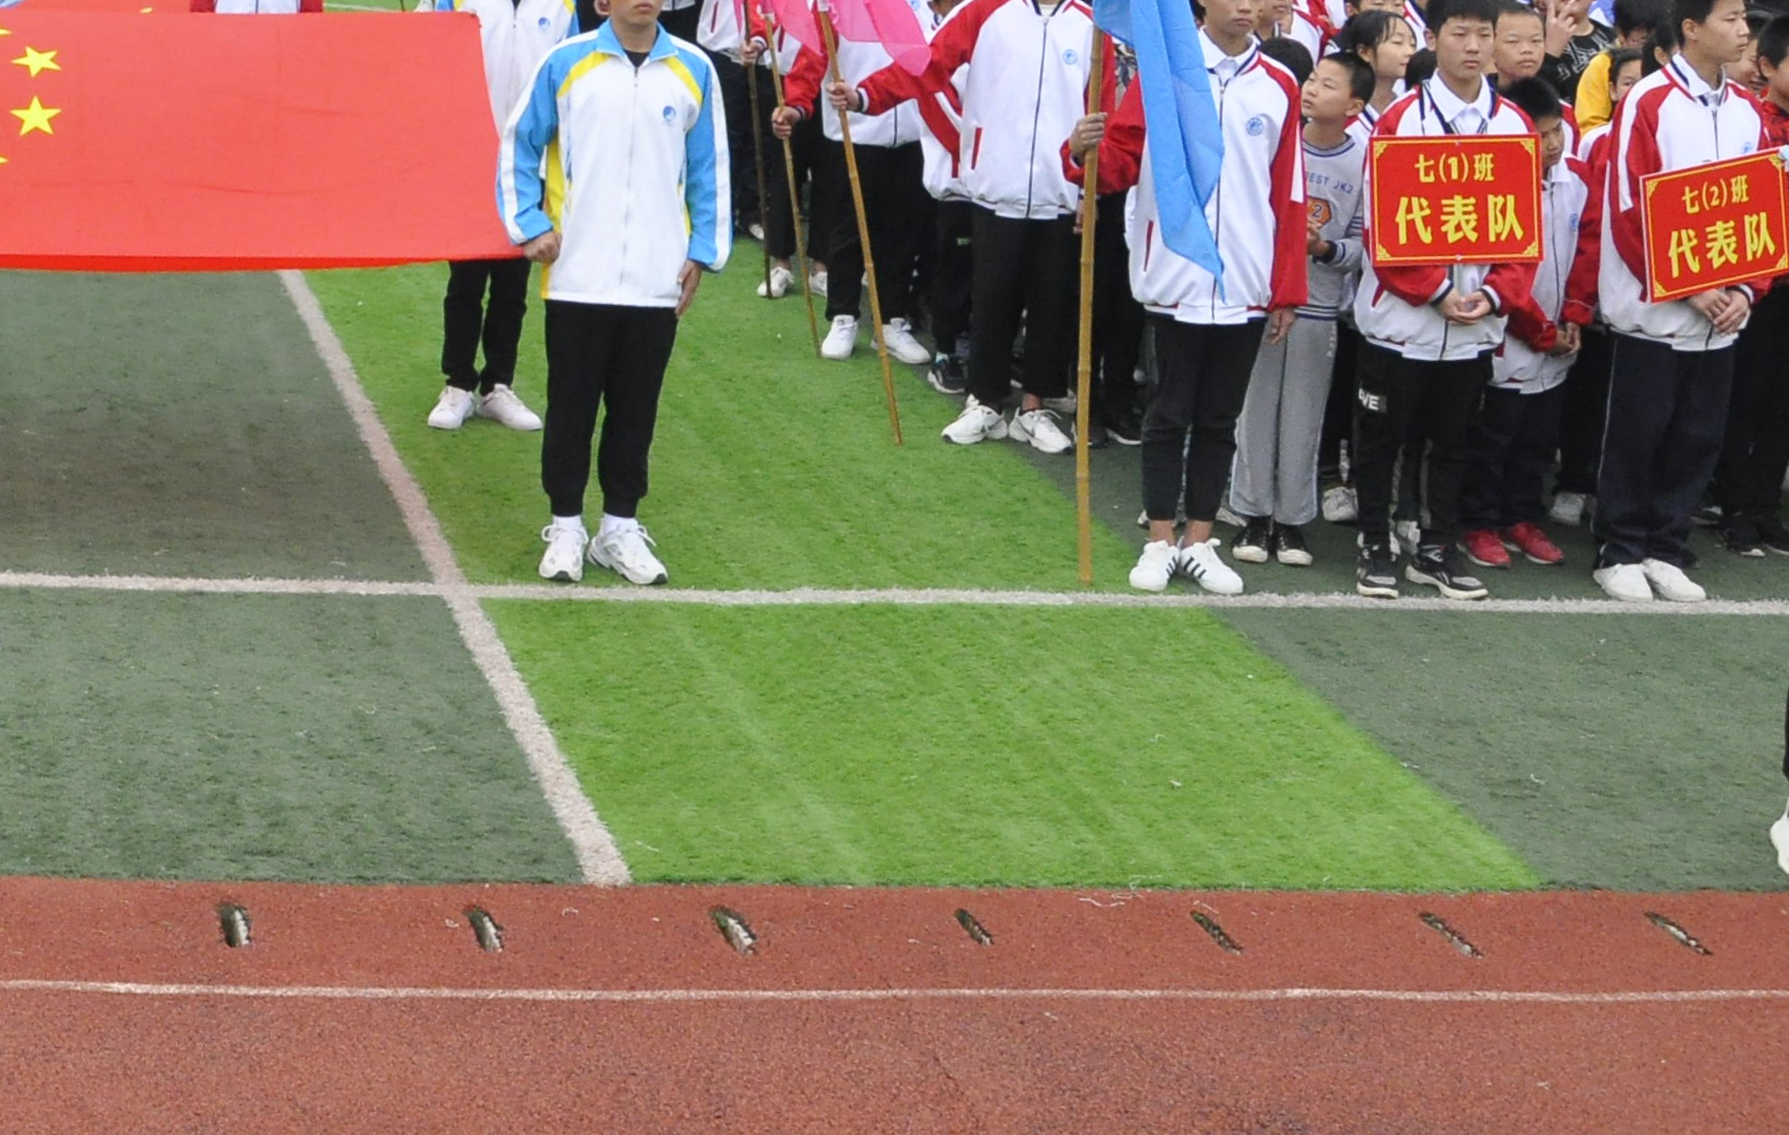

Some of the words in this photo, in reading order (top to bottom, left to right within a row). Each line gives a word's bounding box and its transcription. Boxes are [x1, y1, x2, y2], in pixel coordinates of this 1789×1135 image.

[1307, 171, 1330, 186] EST
[1395, 194, 1524, 246] 代表队
[1667, 211, 1776, 278] 代表队
